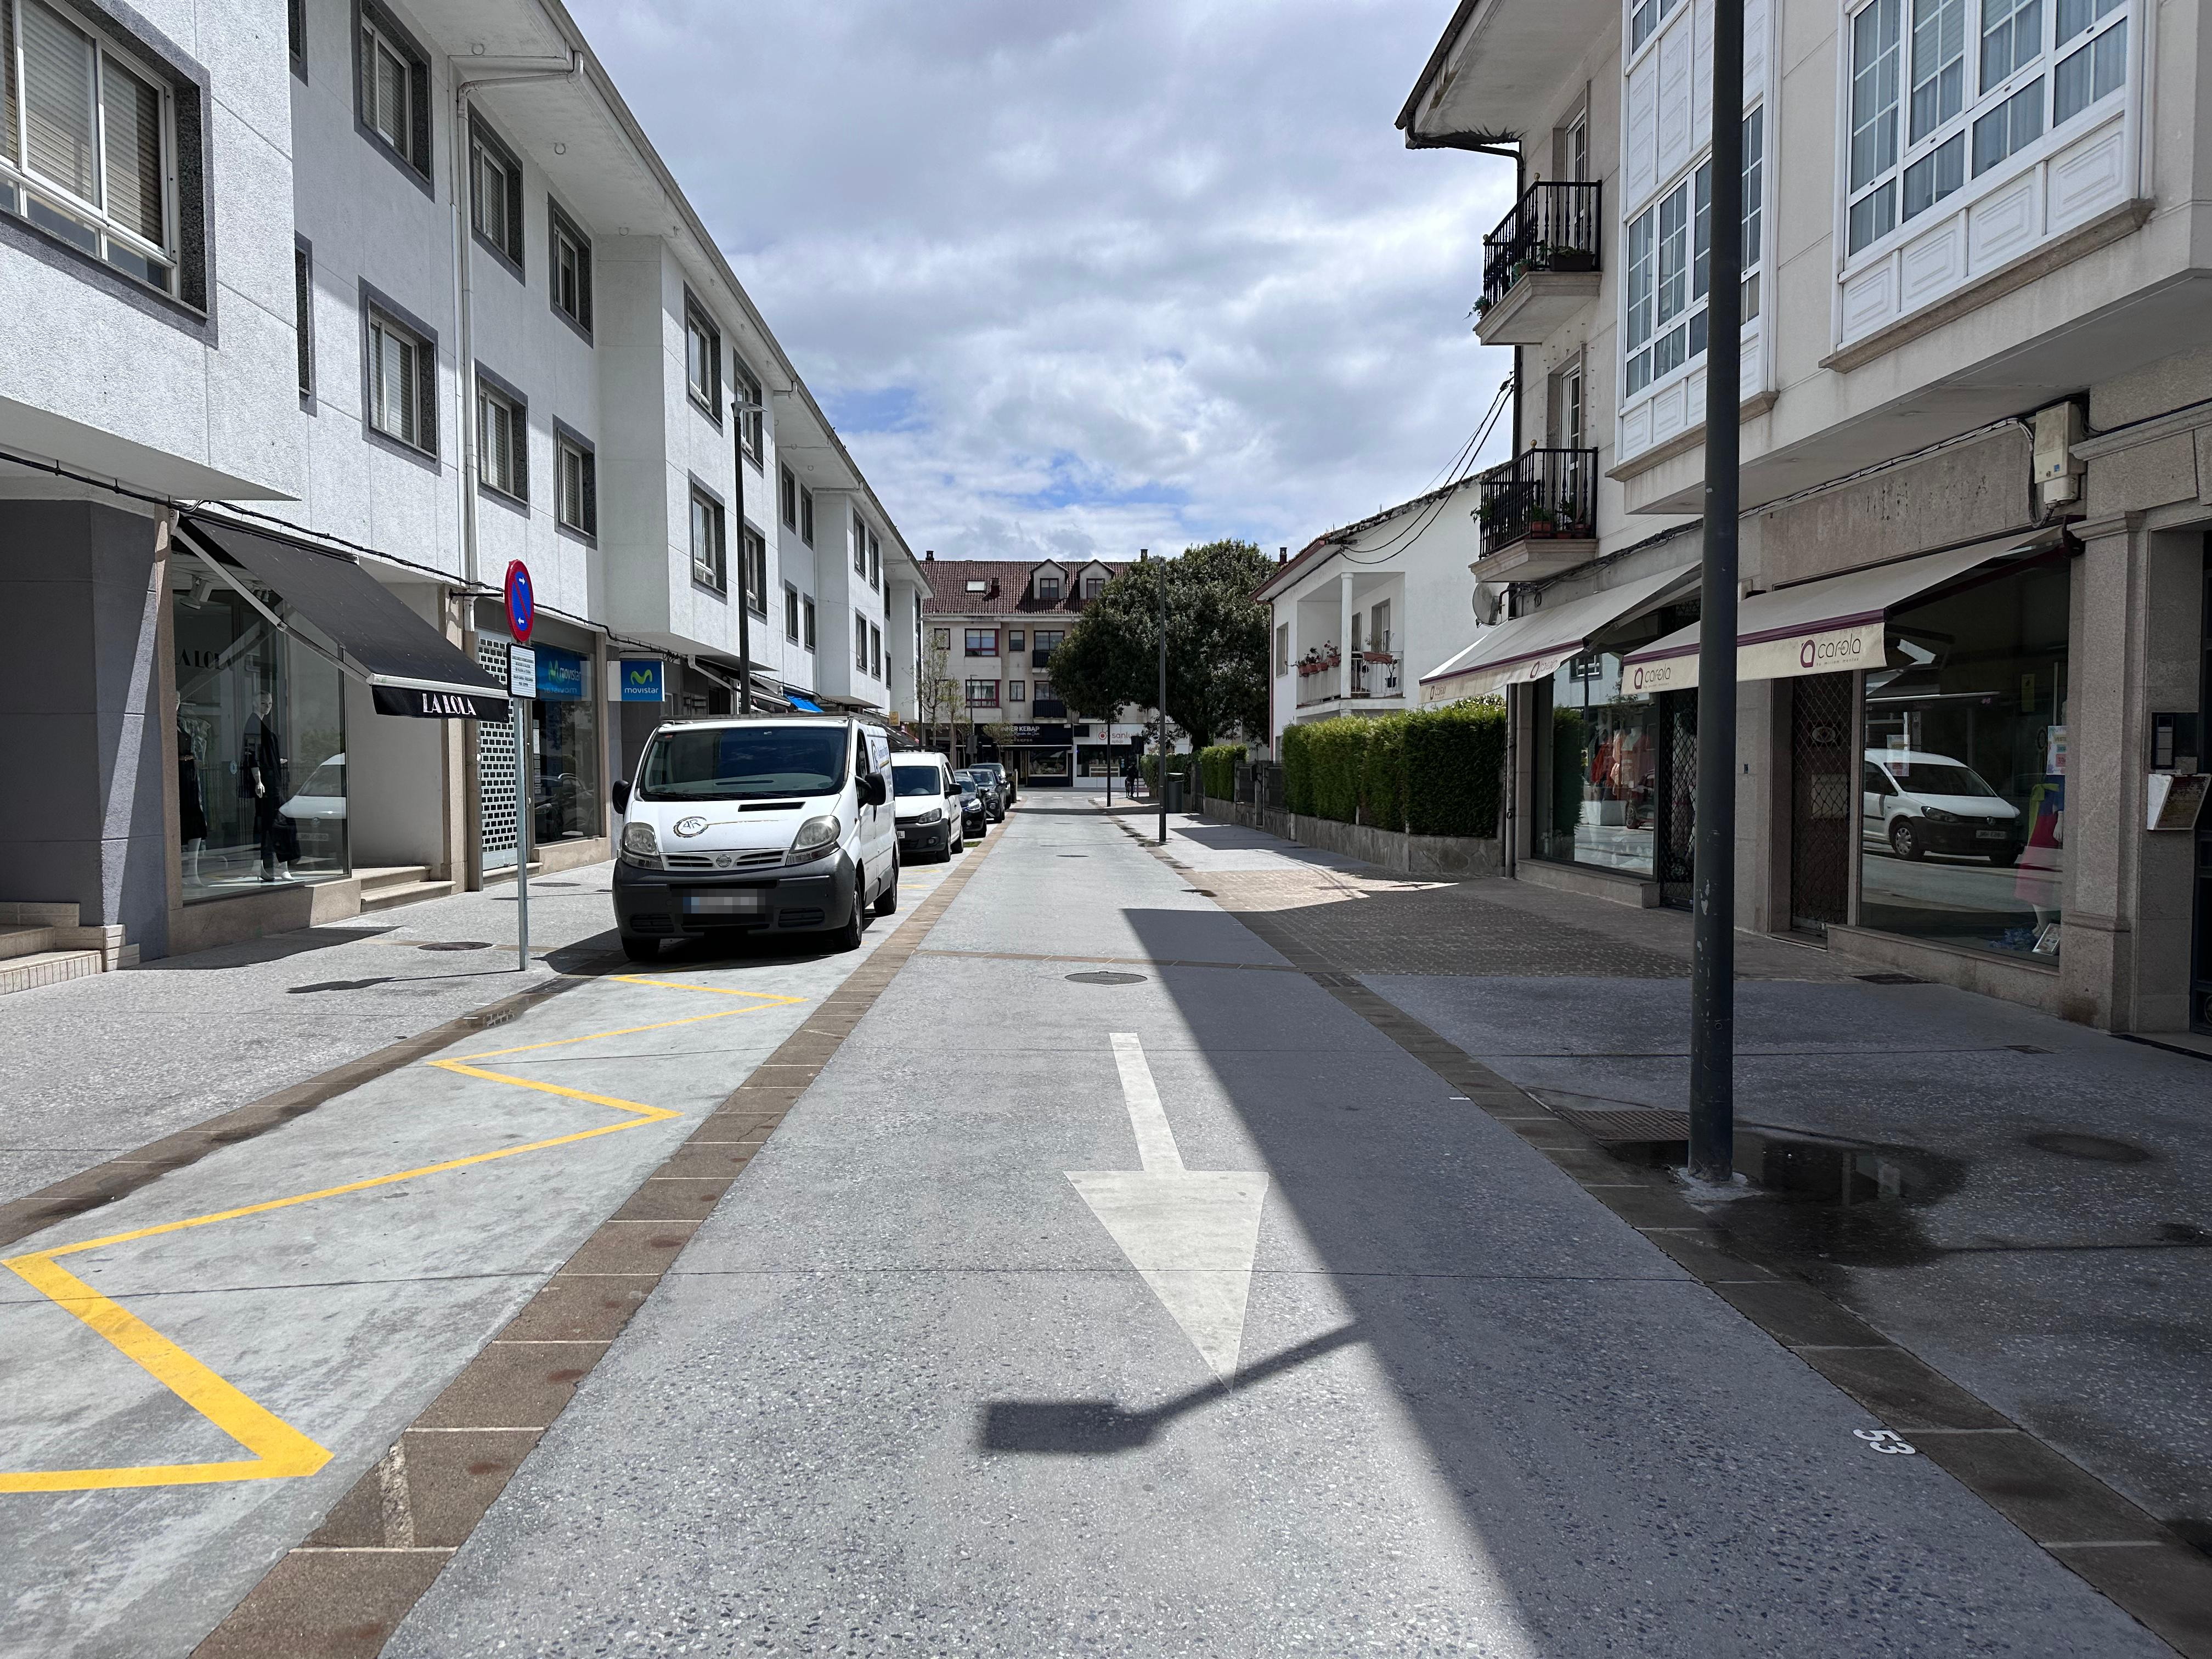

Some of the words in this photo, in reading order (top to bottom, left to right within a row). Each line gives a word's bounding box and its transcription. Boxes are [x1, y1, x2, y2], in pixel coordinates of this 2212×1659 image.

[1818, 633, 1861, 658] carola
[559, 667, 581, 681] movistar
[1645, 663, 1671, 683] carola
[422, 693, 442, 713] LA
[442, 695, 477, 715] LOLA
[680, 819, 702, 830] AR
[1853, 1429, 1916, 1454] 53
